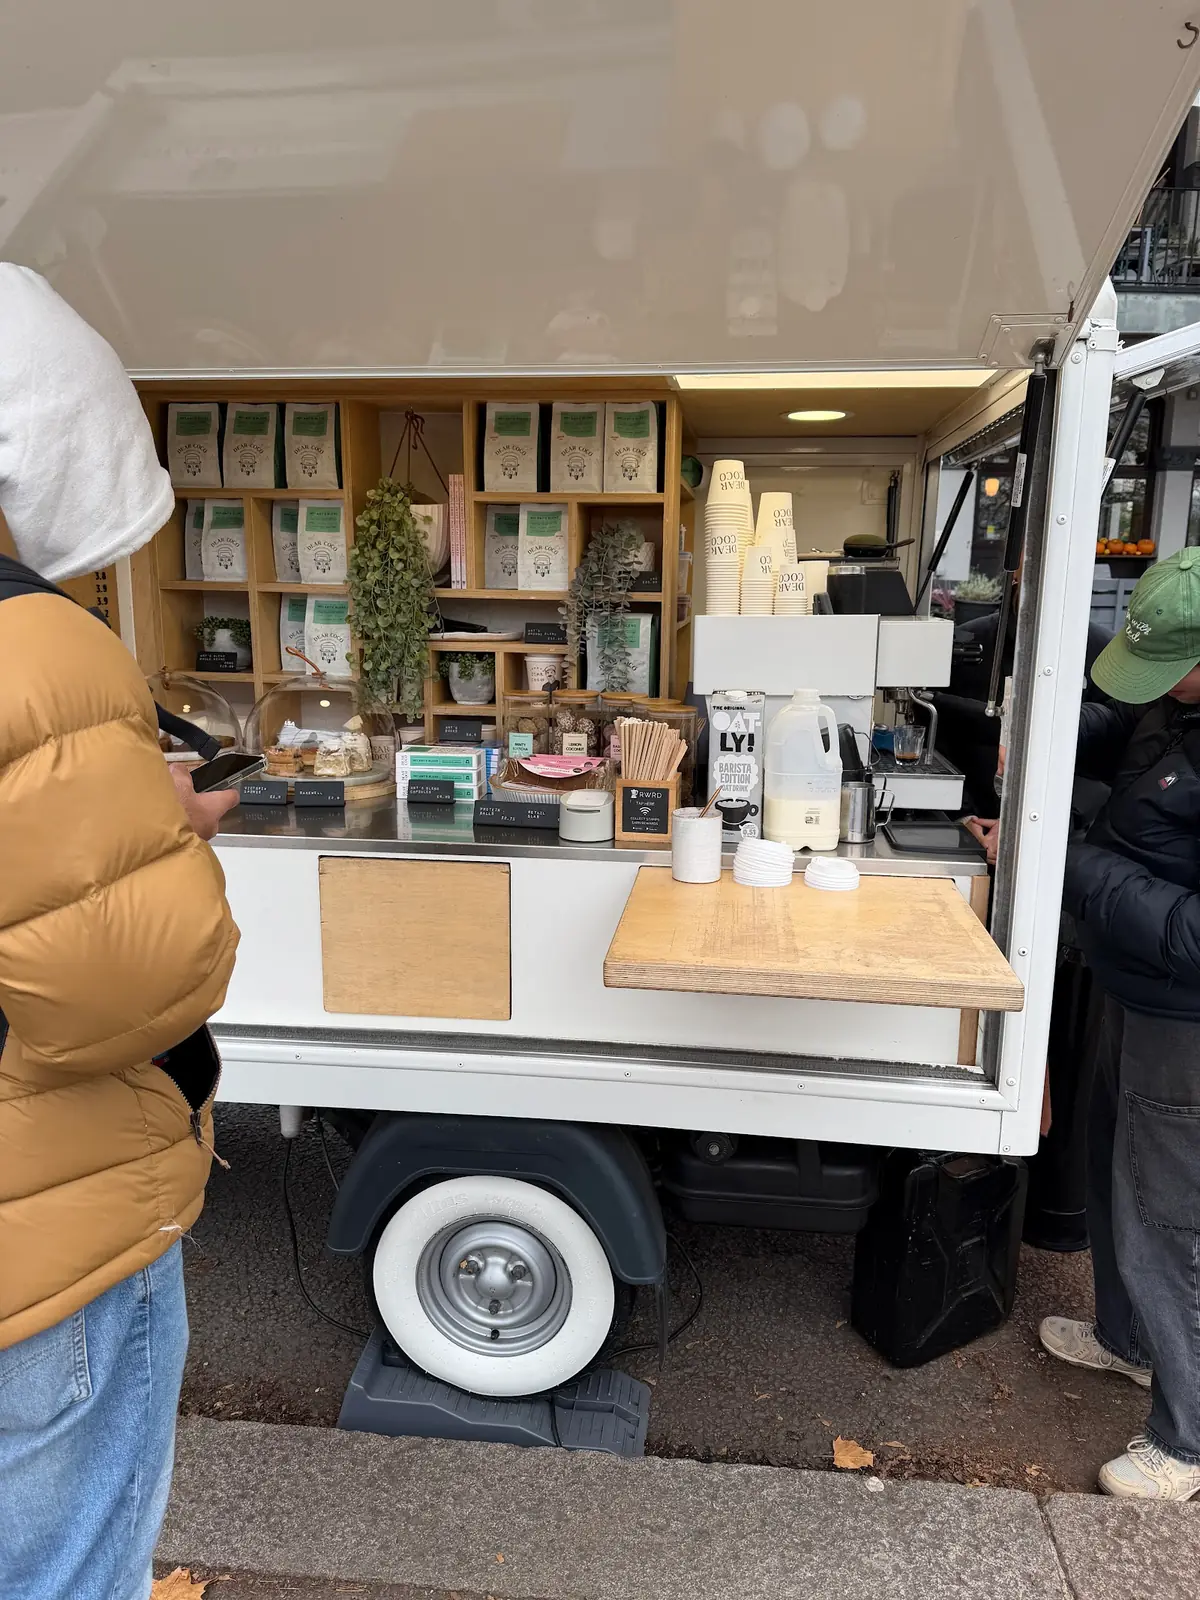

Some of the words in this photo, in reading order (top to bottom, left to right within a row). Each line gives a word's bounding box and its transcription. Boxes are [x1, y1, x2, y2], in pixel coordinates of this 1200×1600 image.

[494, 445, 511, 456] DEAR
[511, 445, 527, 456] COCO
[560, 445, 577, 457] DEAR
[578, 445, 594, 457] COCO
[614, 446, 631, 457] DEAR
[631, 446, 647, 457] COCO
[719, 471, 744, 482] COCO
[720, 481, 745, 491] DEAR
[773, 509, 792, 518] OCO
[774, 518, 793, 527] EAR
[210, 538, 225, 548] DEAR
[226, 537, 241, 548] COCO
[711, 534, 737, 546] COCO
[307, 540, 322, 551] DEAR
[323, 540, 339, 552] COCO
[494, 544, 510, 555] DEAR
[527, 545, 543, 555] DEAR
[544, 545, 560, 555] COCO
[711, 545, 737, 555] DEAR
[760, 556, 772, 565] CO
[761, 565, 773, 574] AR
[779, 572, 804, 583] COCO
[779, 582, 804, 592] DEAR
[97, 597, 108, 606] 3.9
[313, 633, 329, 643] DEAR
[329, 632, 345, 643] COCO
[720, 732, 755, 753] LY!
[718, 762, 752, 774] BARISTA
[720, 773, 751, 784] EDITION
[639, 791, 663, 799] RWRD
